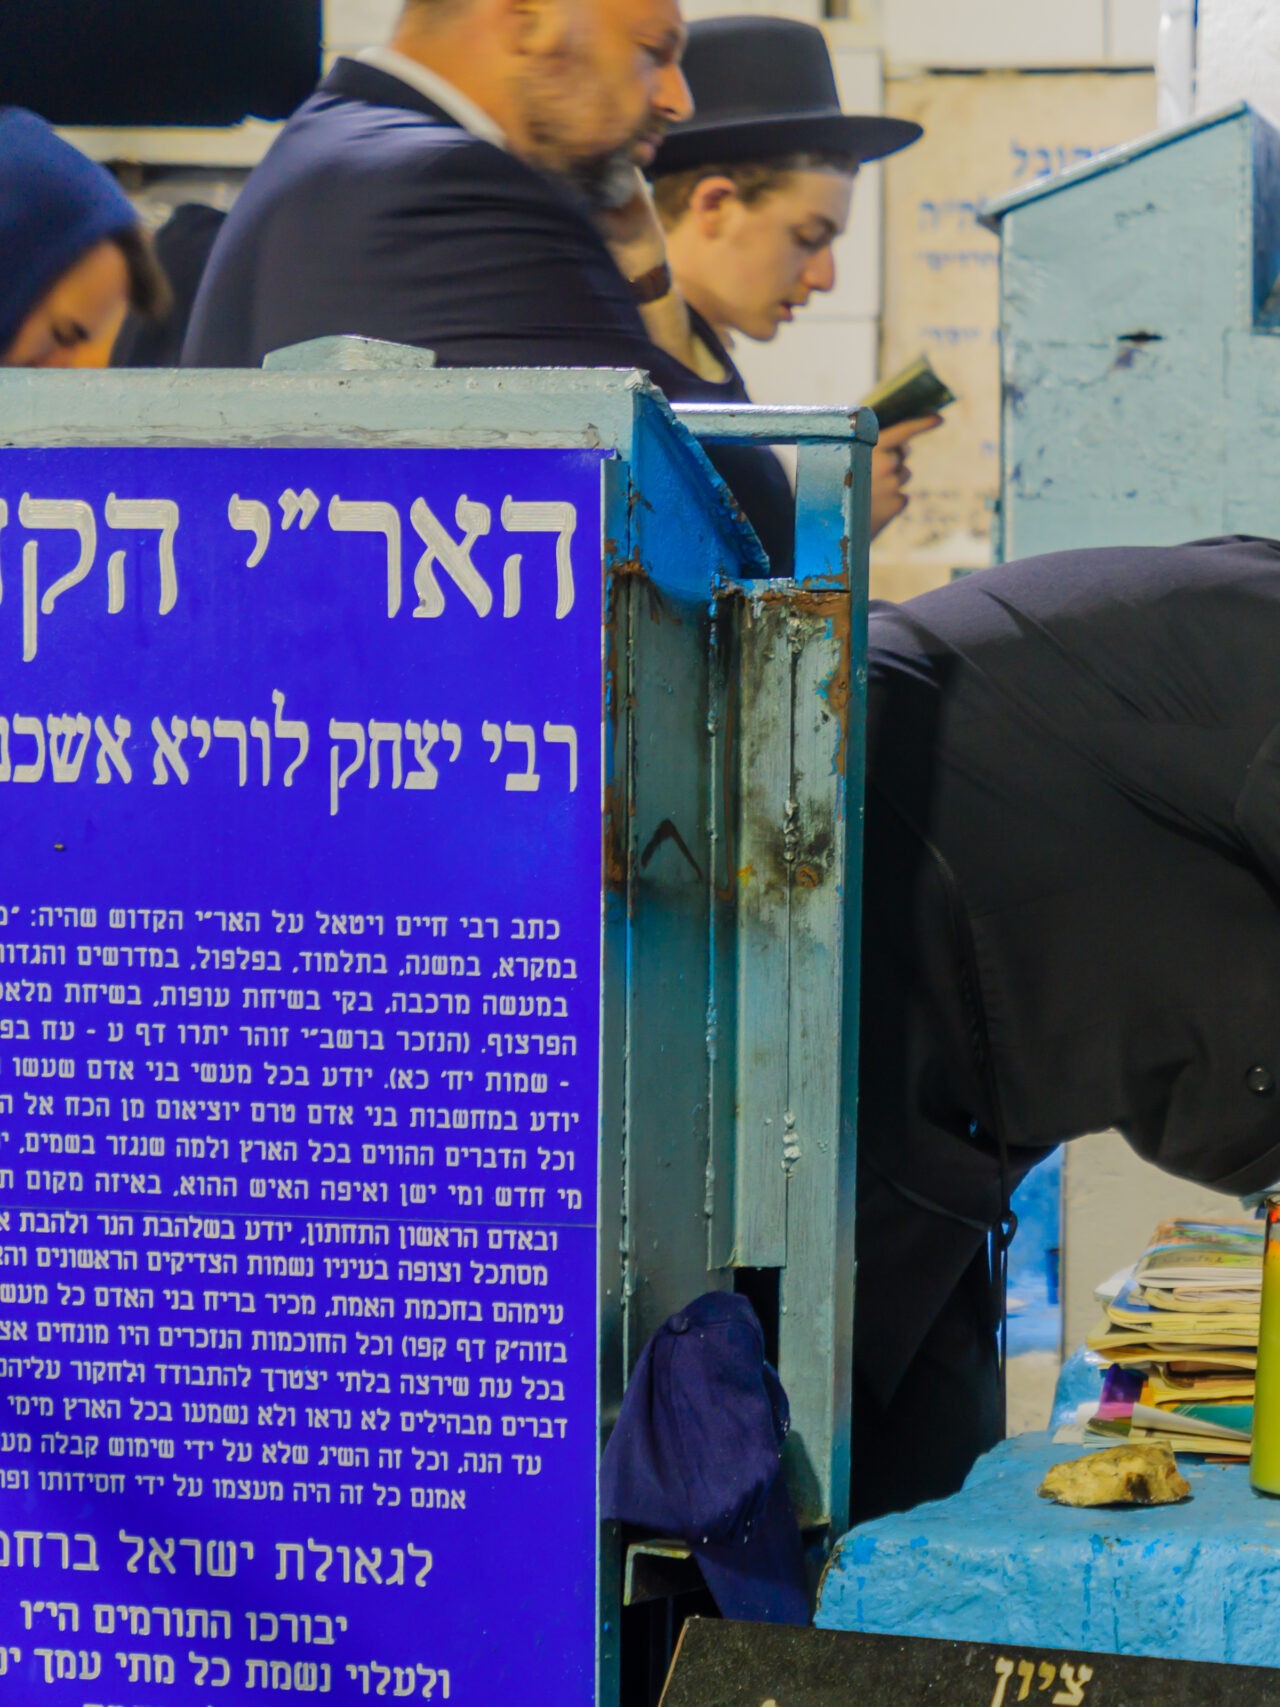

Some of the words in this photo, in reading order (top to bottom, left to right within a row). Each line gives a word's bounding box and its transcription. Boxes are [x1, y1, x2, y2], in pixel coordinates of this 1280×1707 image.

[0, 491, 180, 663] הק
[150, 688, 310, 788] לוריא
[328, 717, 463, 816] יצחק
[481, 719, 578, 793] רבי
[108, 908, 184, 933] הקדוש
[315, 910, 384, 936] ויטאל
[395, 915, 449, 937] חיים
[459, 916, 499, 939] רבי
[510, 918, 561, 940] כתב
[76, 945, 180, 969] במדרשים
[64, 982, 142, 1006] בשיחת
[242, 987, 321, 1011] בשיחת
[332, 990, 374, 1015] בקי
[482, 994, 569, 1018] במעשה
[135, 1022, 167, 1047] דף
[177, 1024, 229, 1045] יתרו
[239, 1026, 290, 1047] זוהר
[12, 1056, 75, 1079] שעשו
[86, 1059, 135, 1081] אדם
[145, 1060, 180, 1082] בני
[190, 1062, 252, 1085] מעשי
[263, 1061, 310, 1087] בכל
[322, 1066, 373, 1088] יודע
[485, 1071, 548, 1094] שמות
[23, 1091, 54, 1116] אל
[64, 1095, 110, 1118] הכח
[120, 1097, 145, 1122] מן
[155, 1098, 240, 1121] יוציאום
[250, 1102, 296, 1123] טרם
[307, 1103, 354, 1126] אדם
[364, 1105, 398, 1127] בני
[409, 1107, 519, 1131] במחשבות
[529, 1111, 580, 1133] יודע
[105, 1135, 166, 1157] שנגזר
[175, 1135, 229, 1159] ולמה
[239, 1139, 298, 1163] הארץ
[307, 1138, 352, 1164] בכל
[361, 1143, 434, 1166] ההווים
[444, 1146, 527, 1170] הדברים
[537, 1146, 575, 1171] וכל
[25, 1169, 84, 1194] מקום
[95, 1172, 162, 1195] באיזה
[249, 1177, 309, 1200] האיש
[320, 1180, 388, 1203] ואיפה
[399, 1183, 437, 1207] ישן
[447, 1184, 483, 1206] ומי
[495, 1186, 546, 1208] חדש
[557, 1188, 582, 1210] מי
[19, 1210, 88, 1234] ולהבת
[96, 1214, 134, 1236] הנר
[142, 1214, 236, 1240] בשלהבת
[244, 1220, 293, 1242] יודע
[398, 1225, 478, 1250] הראשון
[487, 1228, 558, 1251] ובאדם
[35, 1246, 138, 1271] הראשונים
[146, 1250, 238, 1276] הצדיקים
[246, 1254, 314, 1278] נשמות
[323, 1257, 389, 1281] בעיניו
[398, 1260, 461, 1283] וצופה
[469, 1259, 548, 1286] מסתכל
[56, 1282, 86, 1306] כל
[93, 1286, 154, 1309] האדם
[162, 1289, 195, 1311] בני
[202, 1290, 256, 1313] בריח
[264, 1293, 316, 1315] מכיר
[404, 1298, 483, 1322] בחכמת
[491, 1301, 564, 1325] עימהם
[36, 1321, 109, 1345] מונחים
[117, 1324, 150, 1346] היו
[157, 1326, 242, 1350] הנזכרים
[251, 1330, 347, 1354] החוכמות
[355, 1331, 393, 1356] וכל
[456, 1338, 486, 1363] דף
[69, 1359, 146, 1385] ולחקור
[154, 1363, 252, 1388] להתבודד
[260, 1368, 328, 1393] יצטרך
[336, 1369, 391, 1394] בלתי
[400, 1373, 470, 1397] שירצה
[479, 1376, 513, 1399] עת
[521, 1375, 565, 1402] בכל
[7, 1395, 54, 1417] מימי
[62, 1397, 121, 1421] הארץ
[129, 1397, 173, 1422] בכל
[181, 1402, 249, 1425] נשמעו
[257, 1403, 296, 1427] ולא
[305, 1407, 352, 1430] נראו
[360, 1407, 391, 1432] לא
[399, 1409, 492, 1436] מבהילים
[501, 1415, 568, 1439] דברים
[41, 1431, 99, 1458] קבלה
[108, 1436, 175, 1459] שימוש
[261, 1440, 309, 1465] שלא
[317, 1445, 369, 1468] השיג
[378, 1448, 403, 1469] זה
[411, 1446, 449, 1472] וכל
[511, 1454, 542, 1476] עד
[38, 1471, 126, 1493] חסידותו
[212, 1478, 284, 1501] מעצמו
[293, 1482, 331, 1504] היה
[340, 1484, 364, 1505] זה
[372, 1482, 401, 1507] כל
[409, 1487, 466, 1510] אמנם
[118, 1529, 254, 1577] ישראל
[275, 1537, 433, 1588] לגאולת
[92, 1603, 231, 1640] התורמים
[245, 1611, 348, 1645] יבורכו
[33, 1647, 102, 1684] עמך
[114, 1652, 175, 1685] מתי
[188, 1650, 231, 1687] כל
[245, 1659, 331, 1693] נשמת
[345, 1660, 450, 1699] ולעלוי
[990, 1655, 1095, 1707] ציון
